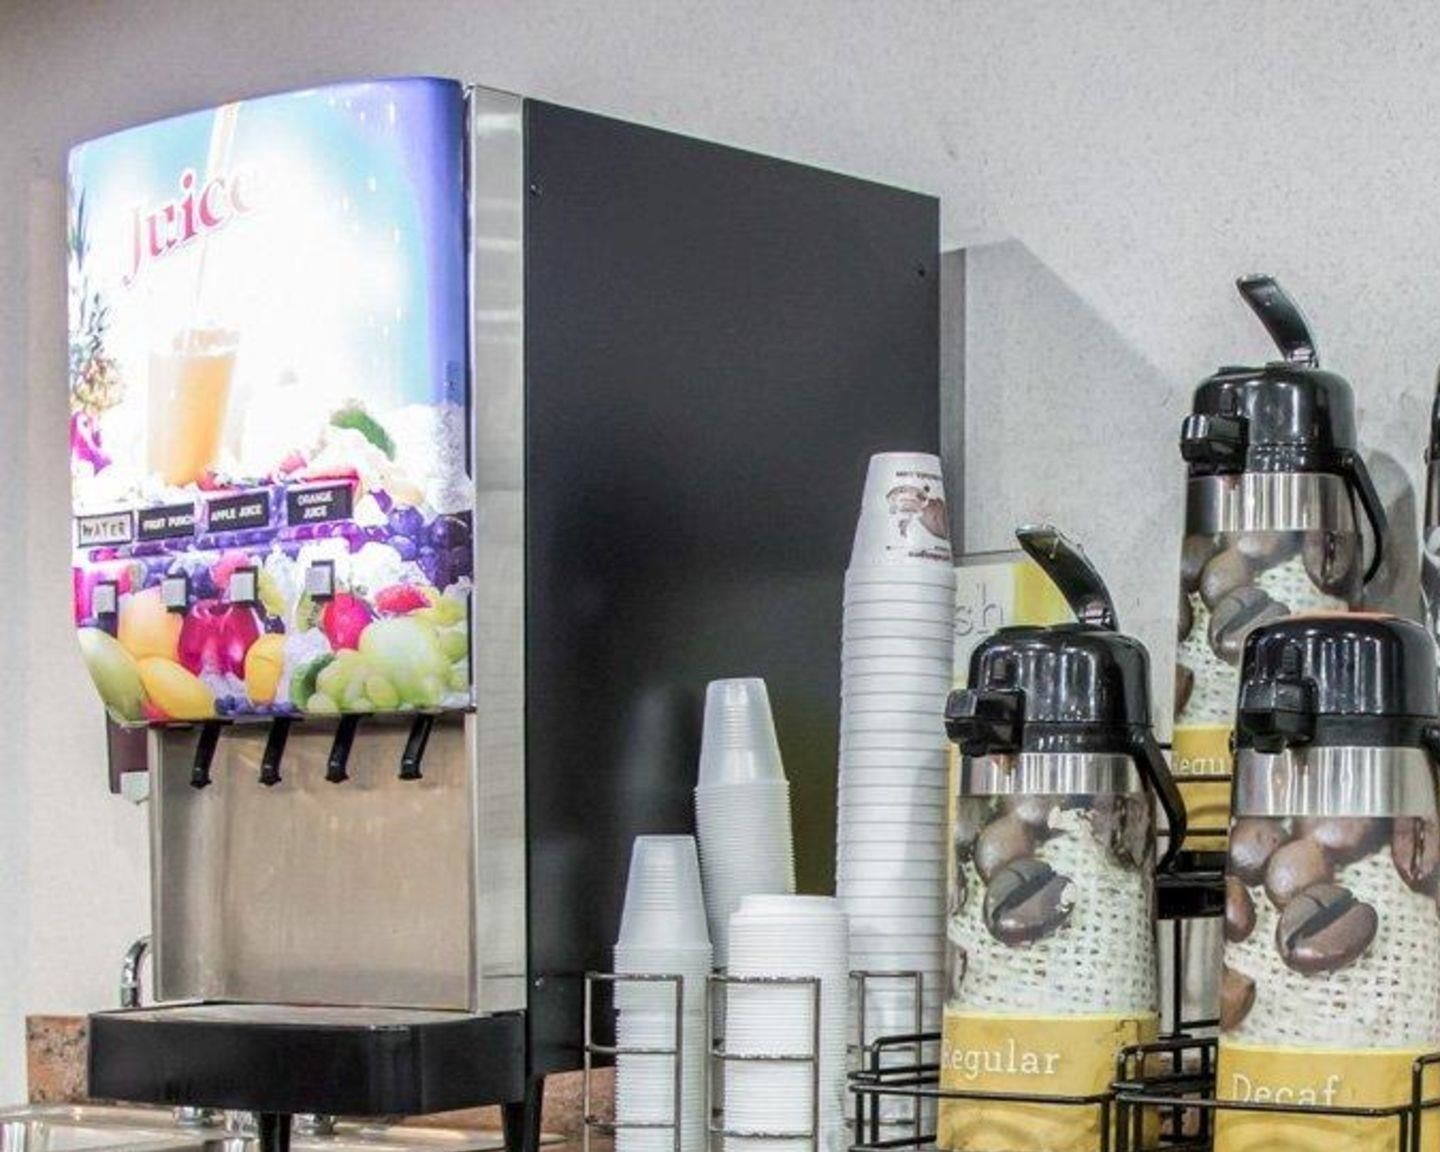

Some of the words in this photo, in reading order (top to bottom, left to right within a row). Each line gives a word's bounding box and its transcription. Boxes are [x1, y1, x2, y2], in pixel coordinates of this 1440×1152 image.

[210, 507, 236, 522] APPLE
[238, 504, 264, 518] JUICE
[302, 505, 328, 519] JUICE
[942, 1038, 1060, 1080] Regular
[1232, 1072, 1339, 1106] Decaf
